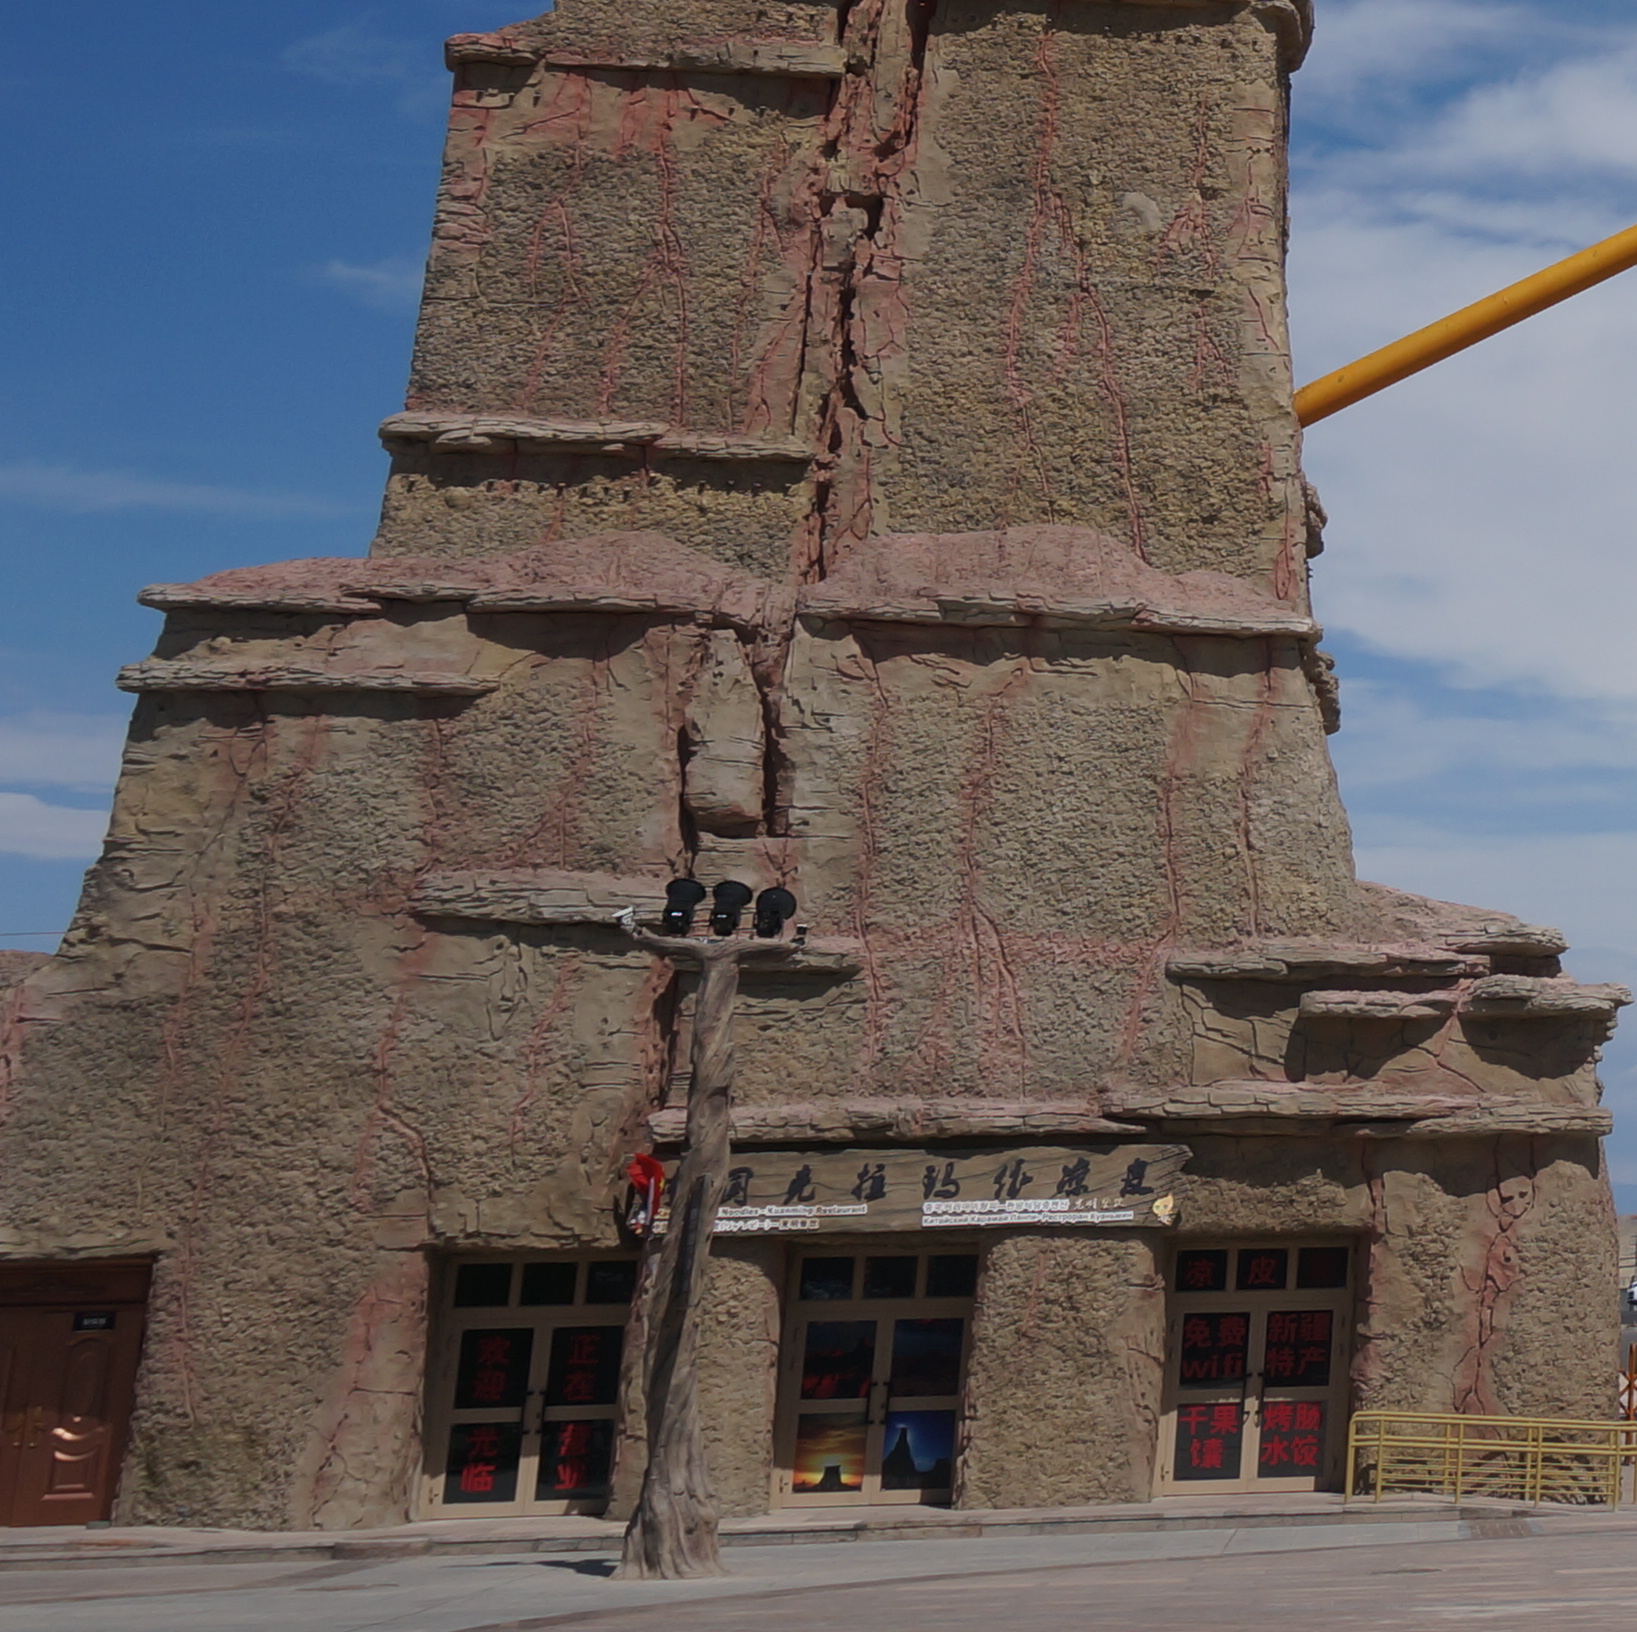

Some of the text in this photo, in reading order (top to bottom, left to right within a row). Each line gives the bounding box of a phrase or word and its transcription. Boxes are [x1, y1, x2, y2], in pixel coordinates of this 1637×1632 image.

[815, 1204, 867, 1215] Restaurant
[1184, 1315, 1247, 1348] 免费
[1267, 1312, 1332, 1344] 新疆
[1267, 1346, 1328, 1379] 特产
[1180, 1405, 1239, 1436] 干果
[1262, 1402, 1323, 1431] 烤肠
[1260, 1435, 1320, 1467] 水饺
